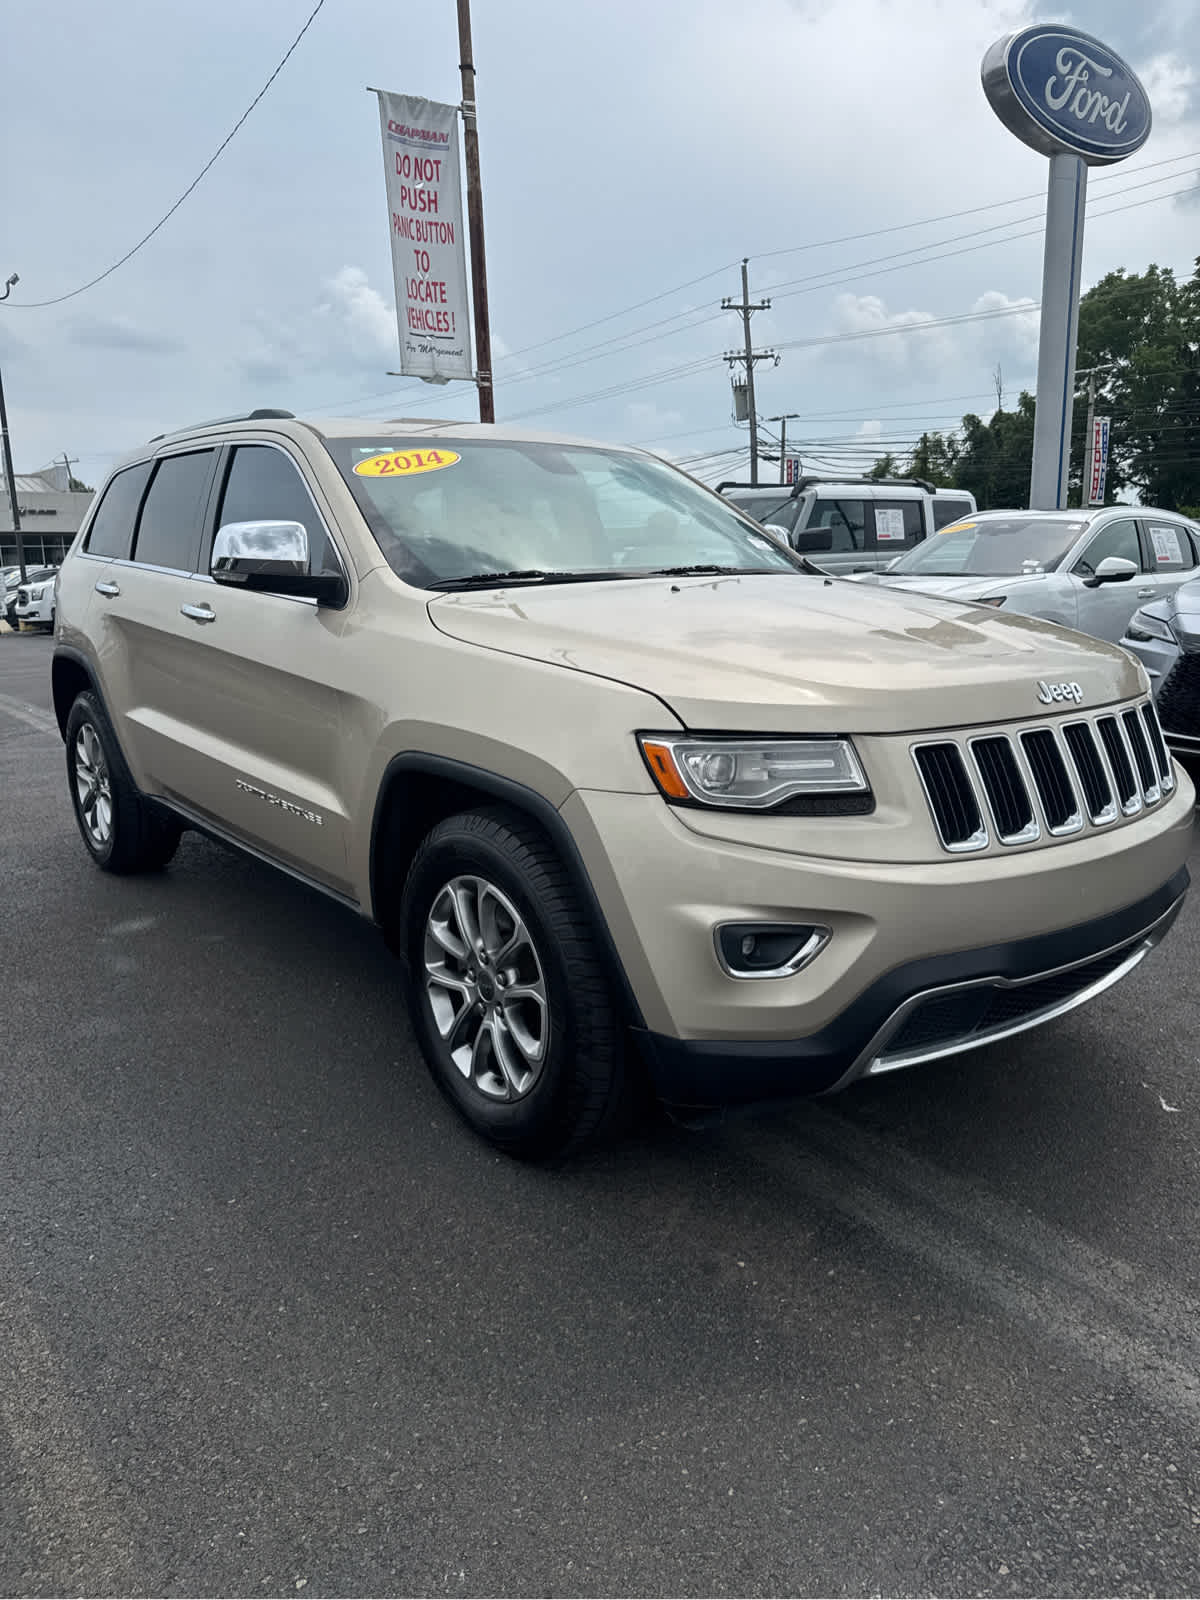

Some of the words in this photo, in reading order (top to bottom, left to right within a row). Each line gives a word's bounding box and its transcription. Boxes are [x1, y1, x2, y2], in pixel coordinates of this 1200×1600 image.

[1045, 47, 1131, 134] Ford
[395, 151, 411, 179] DO
[414, 156, 442, 182] NOT
[401, 185, 438, 213] PUSH
[393, 212, 415, 241] PANIC
[416, 219, 455, 245] BUTTON
[414, 249, 430, 273] TO
[406, 277, 447, 303] LOCATE
[375, 450, 444, 474] 2014
[1037, 681, 1083, 704] Jeep
